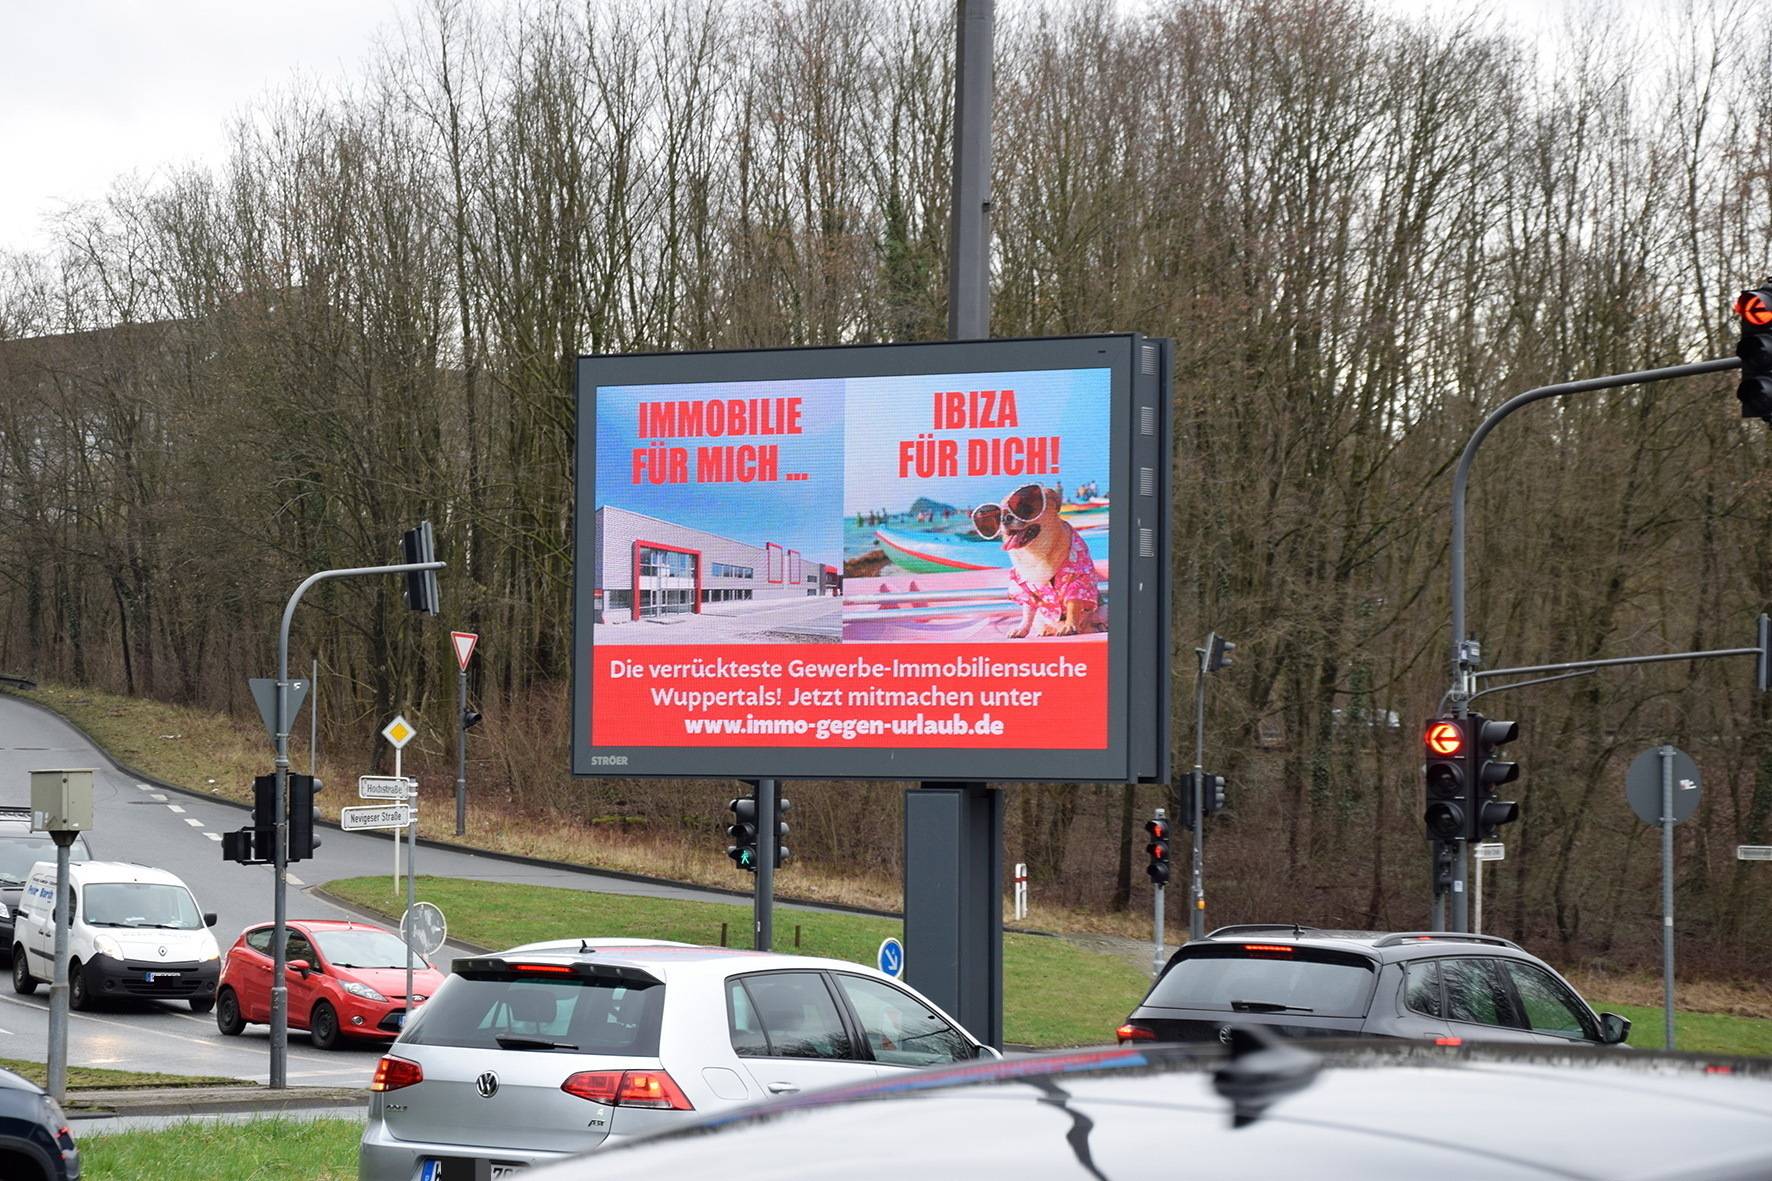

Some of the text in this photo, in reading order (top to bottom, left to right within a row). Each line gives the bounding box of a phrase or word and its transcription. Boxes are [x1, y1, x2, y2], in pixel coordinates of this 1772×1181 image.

[638, 396, 803, 439] IMMOBILIE
[933, 389, 1019, 430] IBIZA
[631, 441, 688, 485] FÜR
[696, 444, 778, 483] MICH
[898, 433, 1061, 478] FÜR DICH!
[609, 656, 1088, 679] Die verrückteste Gewerbe-Immobiliensuche
[651, 685, 1042, 711] Wuppertals! Jetzt mitmachen unter
[684, 713, 1005, 740] www.immo-gegen-urlaub.de
[591, 755, 629, 766] STRÖER
[367, 784, 403, 794] Hochstraße
[350, 811, 401, 825] Nevigeser Straße
